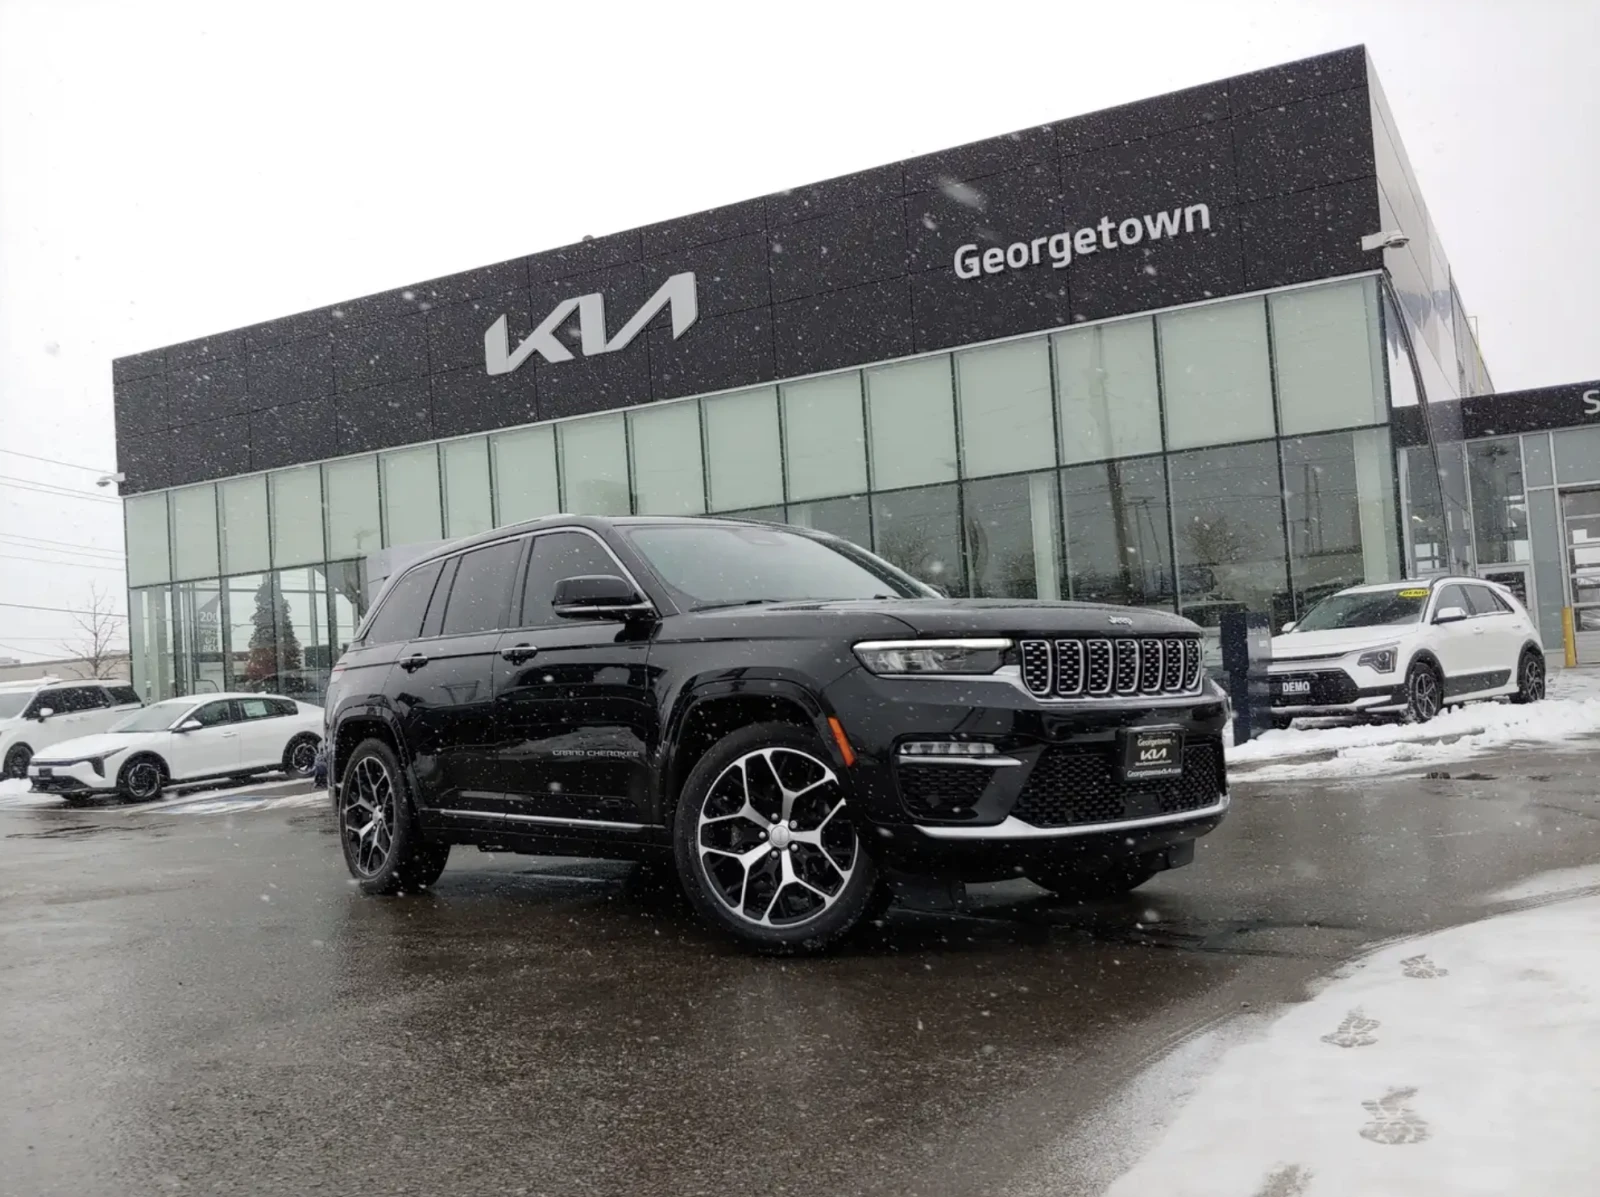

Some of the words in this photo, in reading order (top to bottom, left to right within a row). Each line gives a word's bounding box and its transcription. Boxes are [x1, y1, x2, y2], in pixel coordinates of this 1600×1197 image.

[953, 202, 1211, 279] Georgetown
[484, 271, 698, 376] KIA
[1108, 615, 1133, 625] Jeep
[1282, 681, 1310, 692] DEMO
[1137, 738, 1171, 747] Georgetown
[586, 750, 640, 758] CHEROKEE
[1140, 748, 1167, 760] KIA
